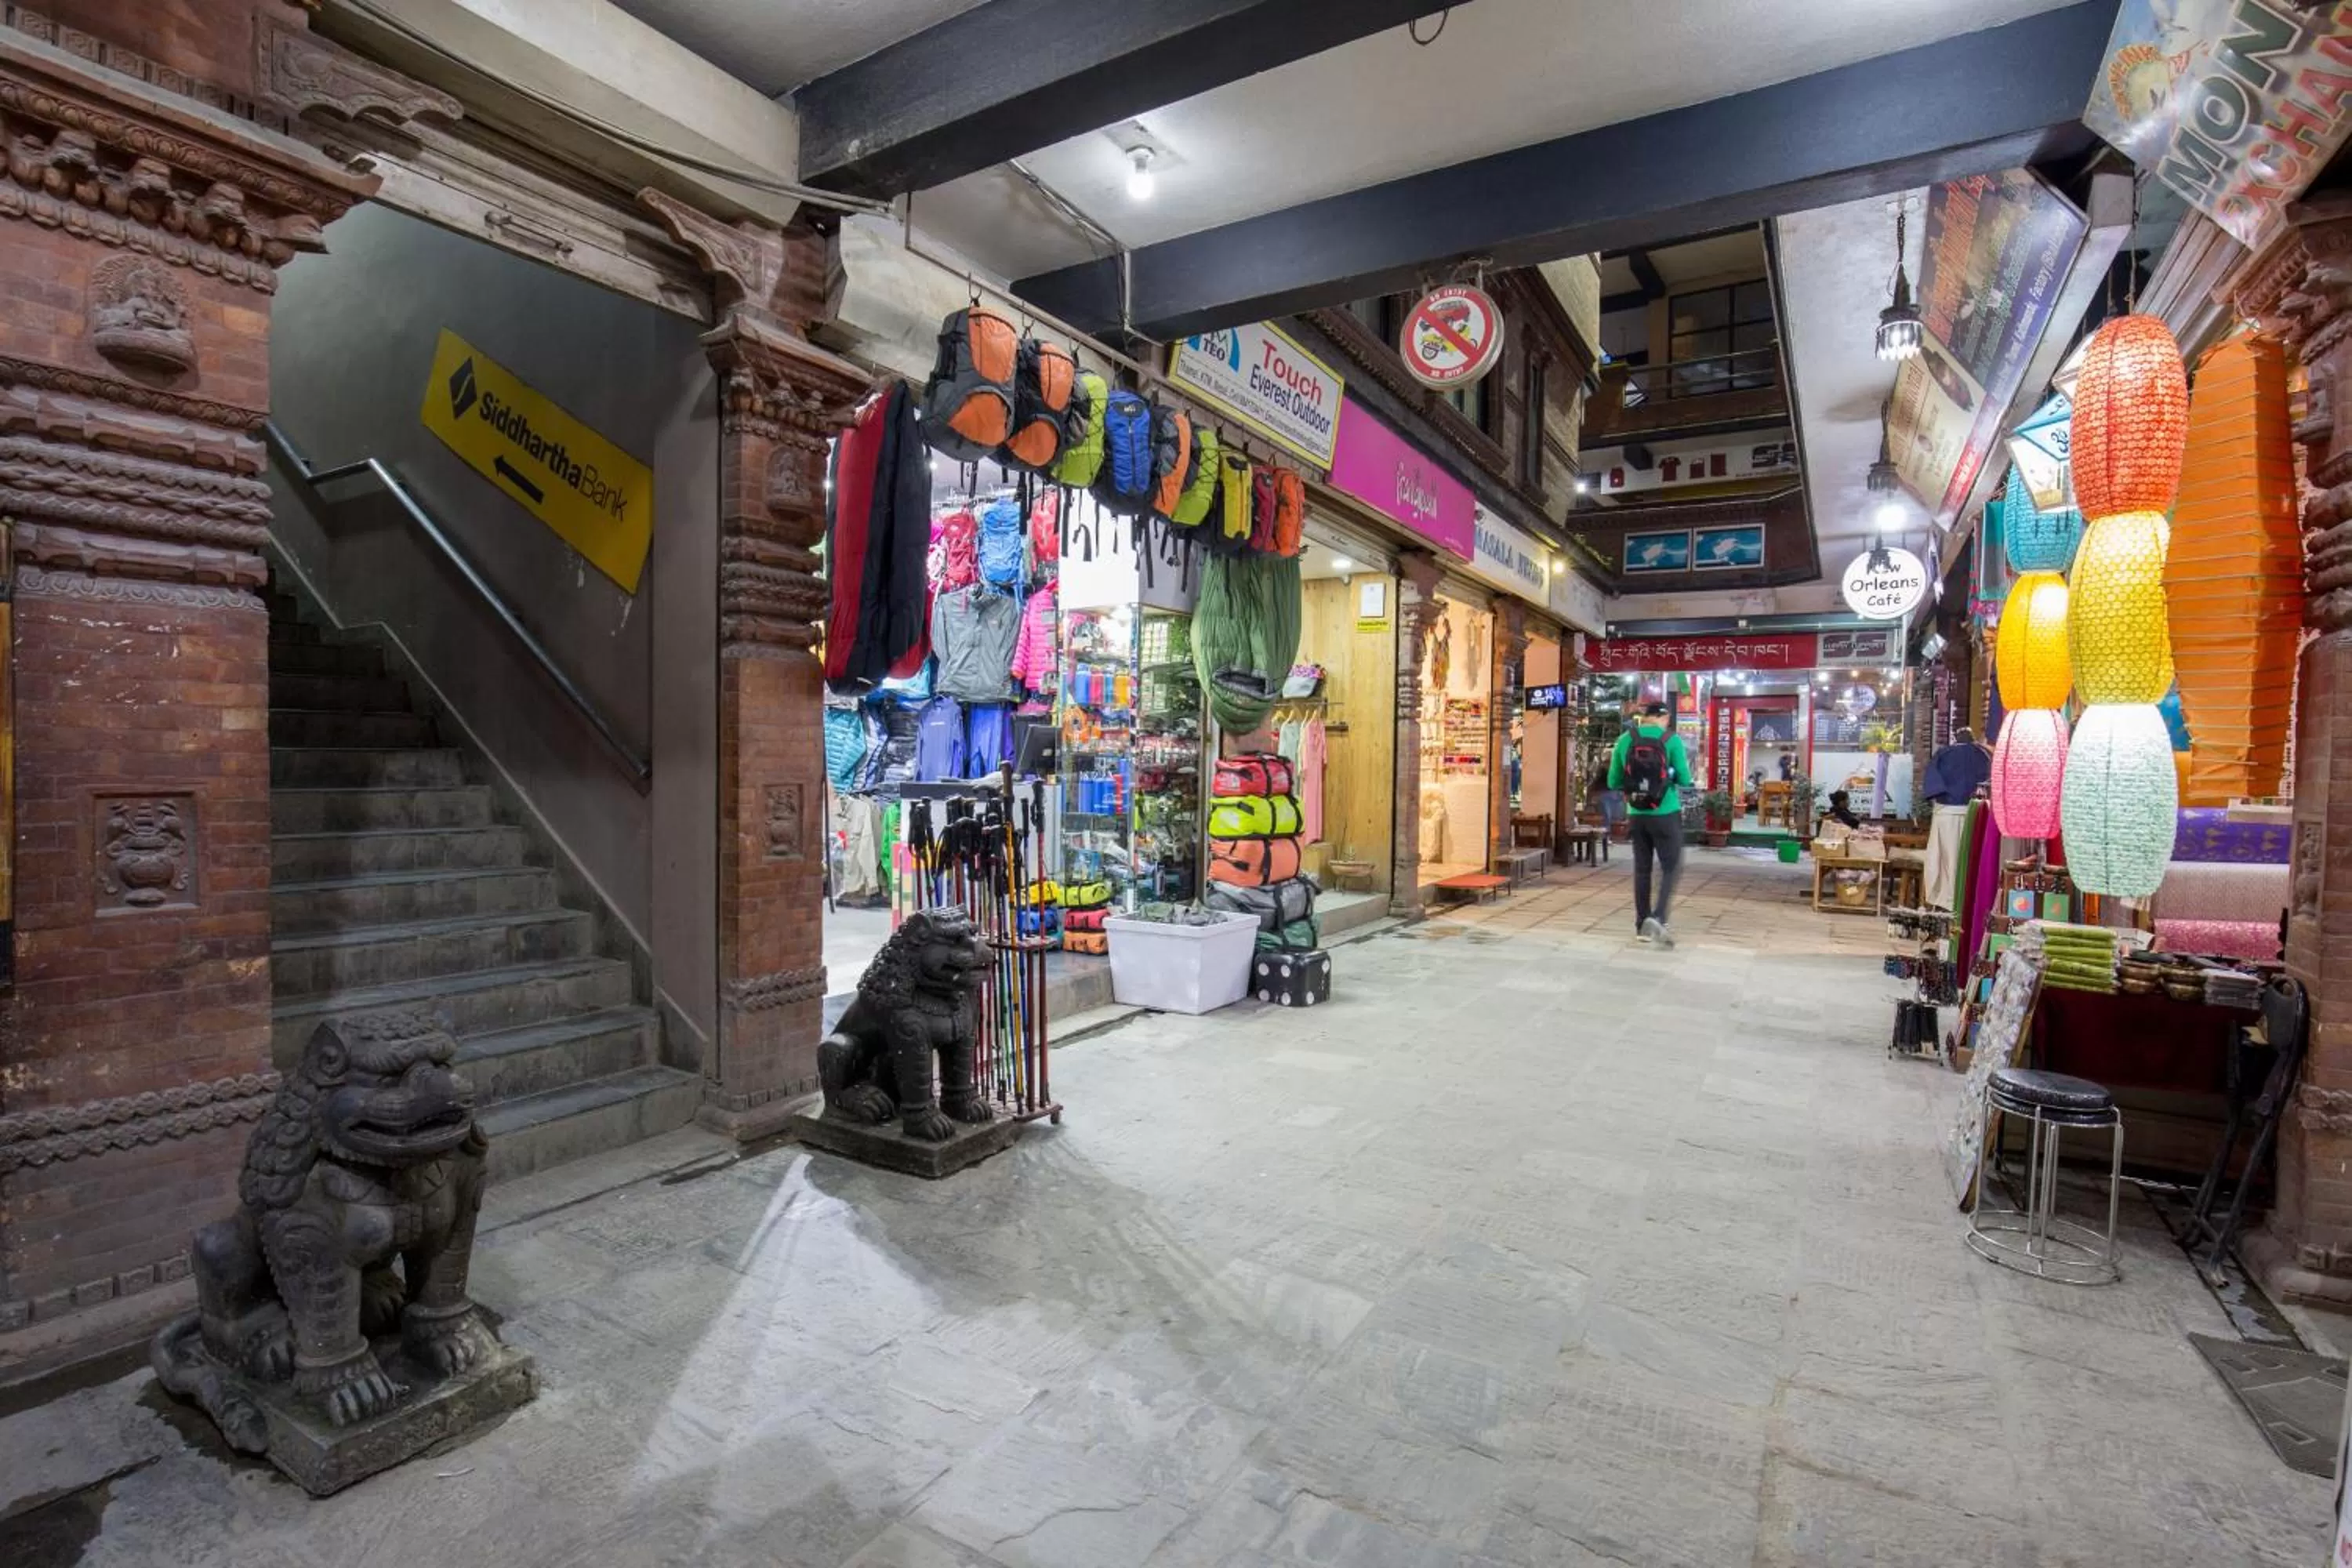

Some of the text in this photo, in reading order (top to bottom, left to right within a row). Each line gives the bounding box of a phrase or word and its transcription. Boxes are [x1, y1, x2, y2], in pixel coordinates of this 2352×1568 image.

[2156, 0, 2313, 205] MON
[1203, 338, 1225, 361] TEO
[1261, 339, 1323, 405] Touch
[1250, 363, 1292, 412] Everest
[1292, 390, 1331, 436] Outdoor
[1849, 576, 1918, 593] Orleans
[1867, 593, 1901, 607] Café
